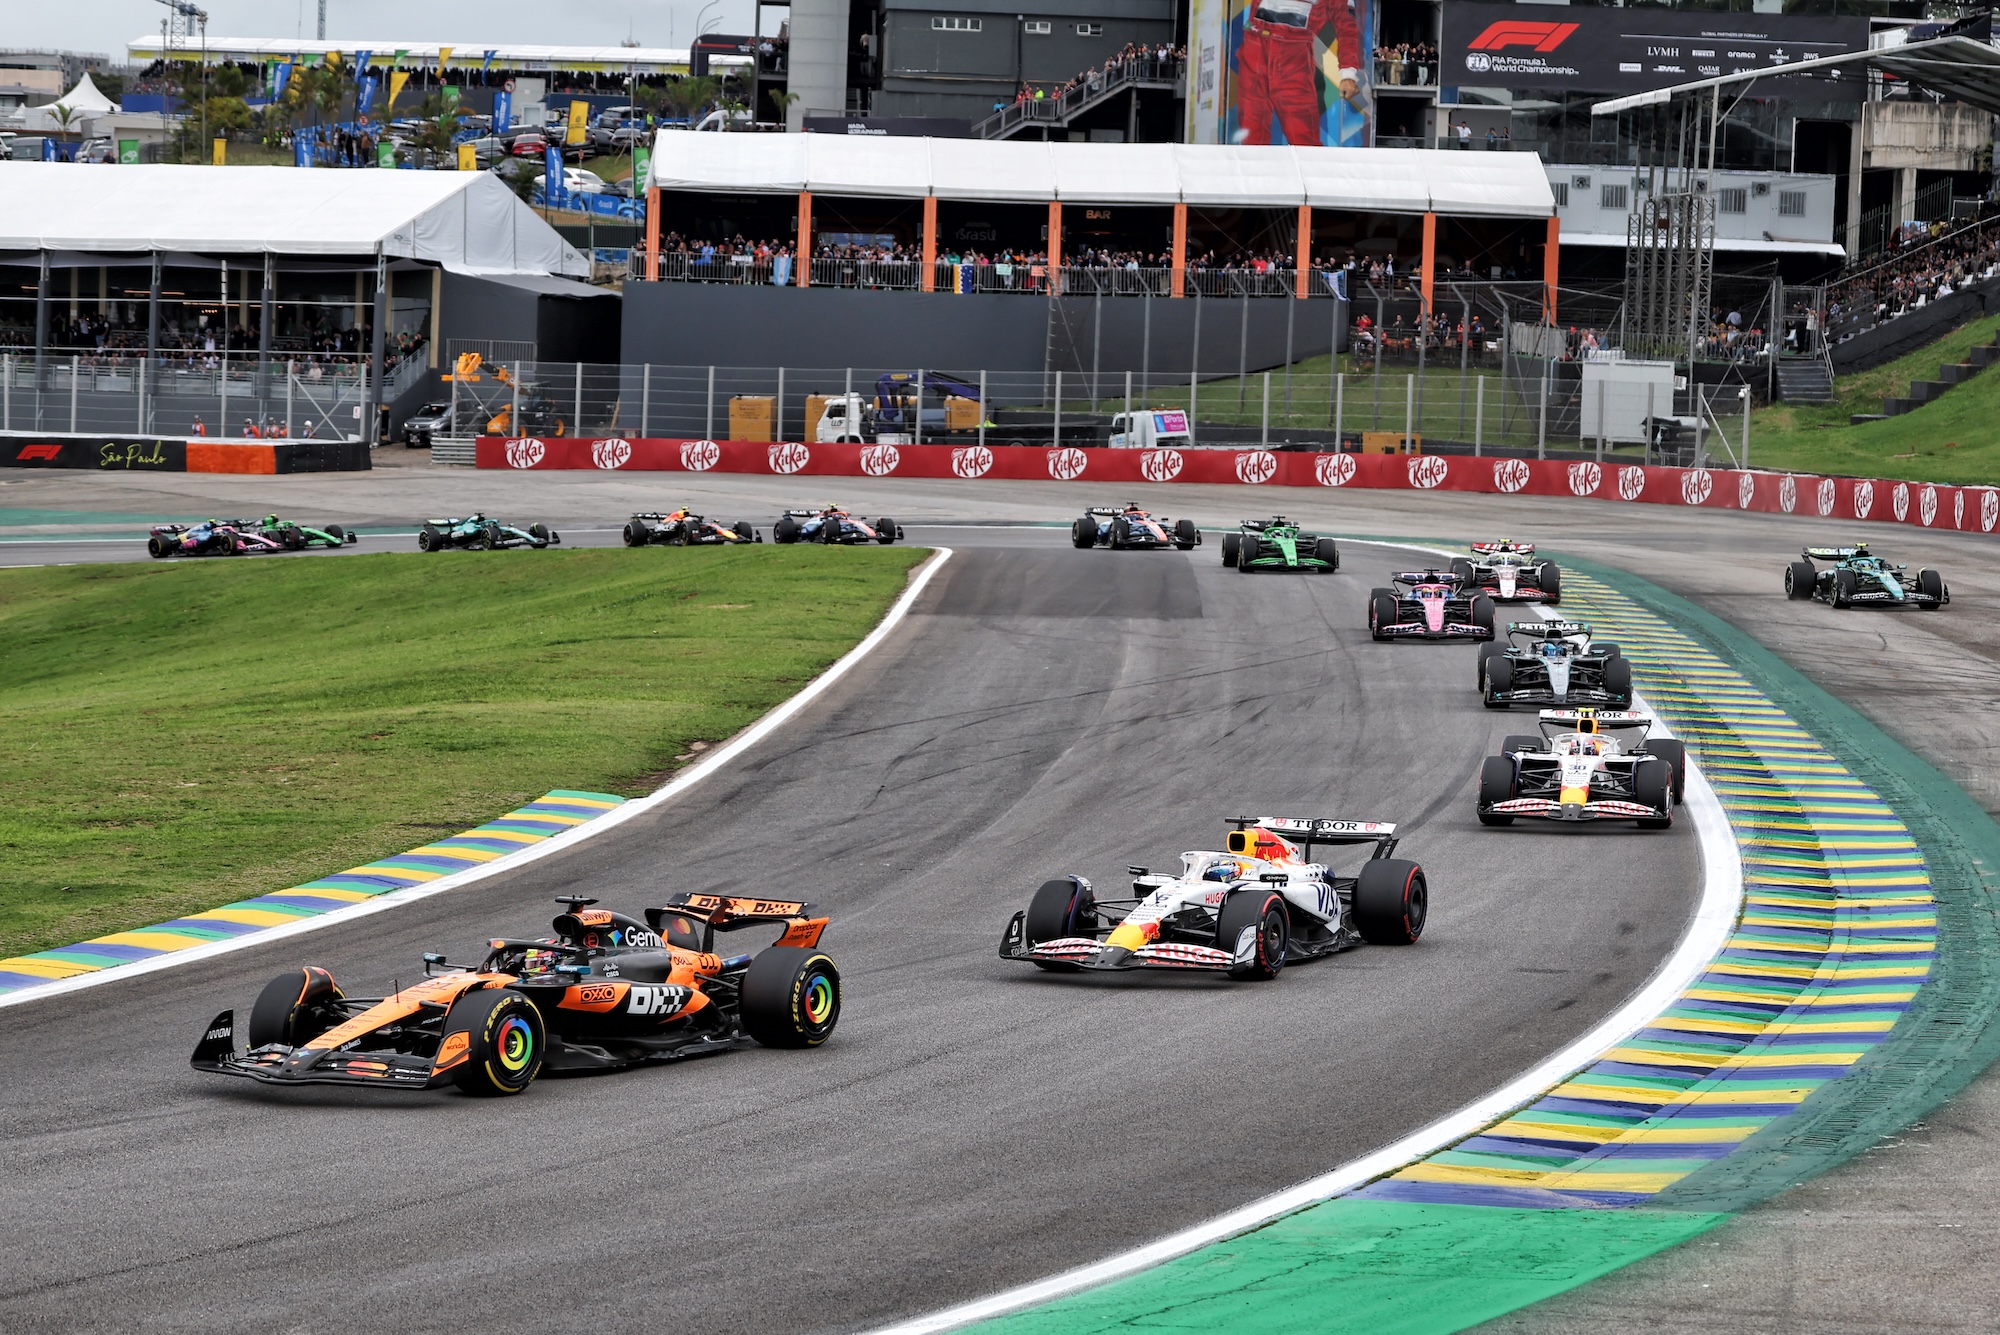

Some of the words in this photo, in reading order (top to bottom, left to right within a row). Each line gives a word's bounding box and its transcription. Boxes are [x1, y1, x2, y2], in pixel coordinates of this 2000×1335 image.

[1467, 20, 1580, 52] F1
[1507, 57, 1541, 66] Formula
[1542, 58, 1547, 66] 1
[1647, 46, 1680, 57] LVMH
[1727, 51, 1756, 59] aramco
[1803, 52, 1819, 60] aws
[1492, 64, 1517, 72] World
[1657, 65, 1681, 73] DHL
[1698, 65, 1720, 73] QATAR
[1086, 210, 1111, 220] BAR
[955, 228, 997, 241] Brasil
[16, 444, 63, 460] F1
[100, 443, 122, 467] São
[126, 440, 167, 469] Paulo
[512, 439, 543, 467] KitKat
[598, 439, 629, 467] KitKat
[686, 440, 717, 470] KitKat
[774, 443, 807, 473] KitKat
[864, 445, 898, 475] KitKat
[958, 447, 991, 477] KitKat
[1052, 448, 1085, 479] KitKat
[1145, 450, 1181, 481] KitKat
[1241, 453, 1275, 482] KitKat
[1320, 454, 1354, 486] KitKat
[1413, 456, 1446, 488] KitKat
[1499, 460, 1527, 491] KitKat
[1573, 463, 1600, 494] KitKat
[1623, 467, 1643, 499] KitKat
[1686, 471, 1710, 503] KitKat
[1499, 799, 1549, 811] HUGO
[1597, 800, 1649, 815] HUGO
[793, 923, 819, 932] Dropbox
[1041, 939, 1095, 953] HUGO
[1154, 944, 1227, 963] HUGO
[673, 956, 693, 966] DELL
[581, 986, 615, 1001] OXXO
[627, 986, 684, 1015] OKX
[793, 981, 801, 1023] ZERO
[486, 996, 511, 1030] ZERO
[446, 1041, 467, 1051] workday
